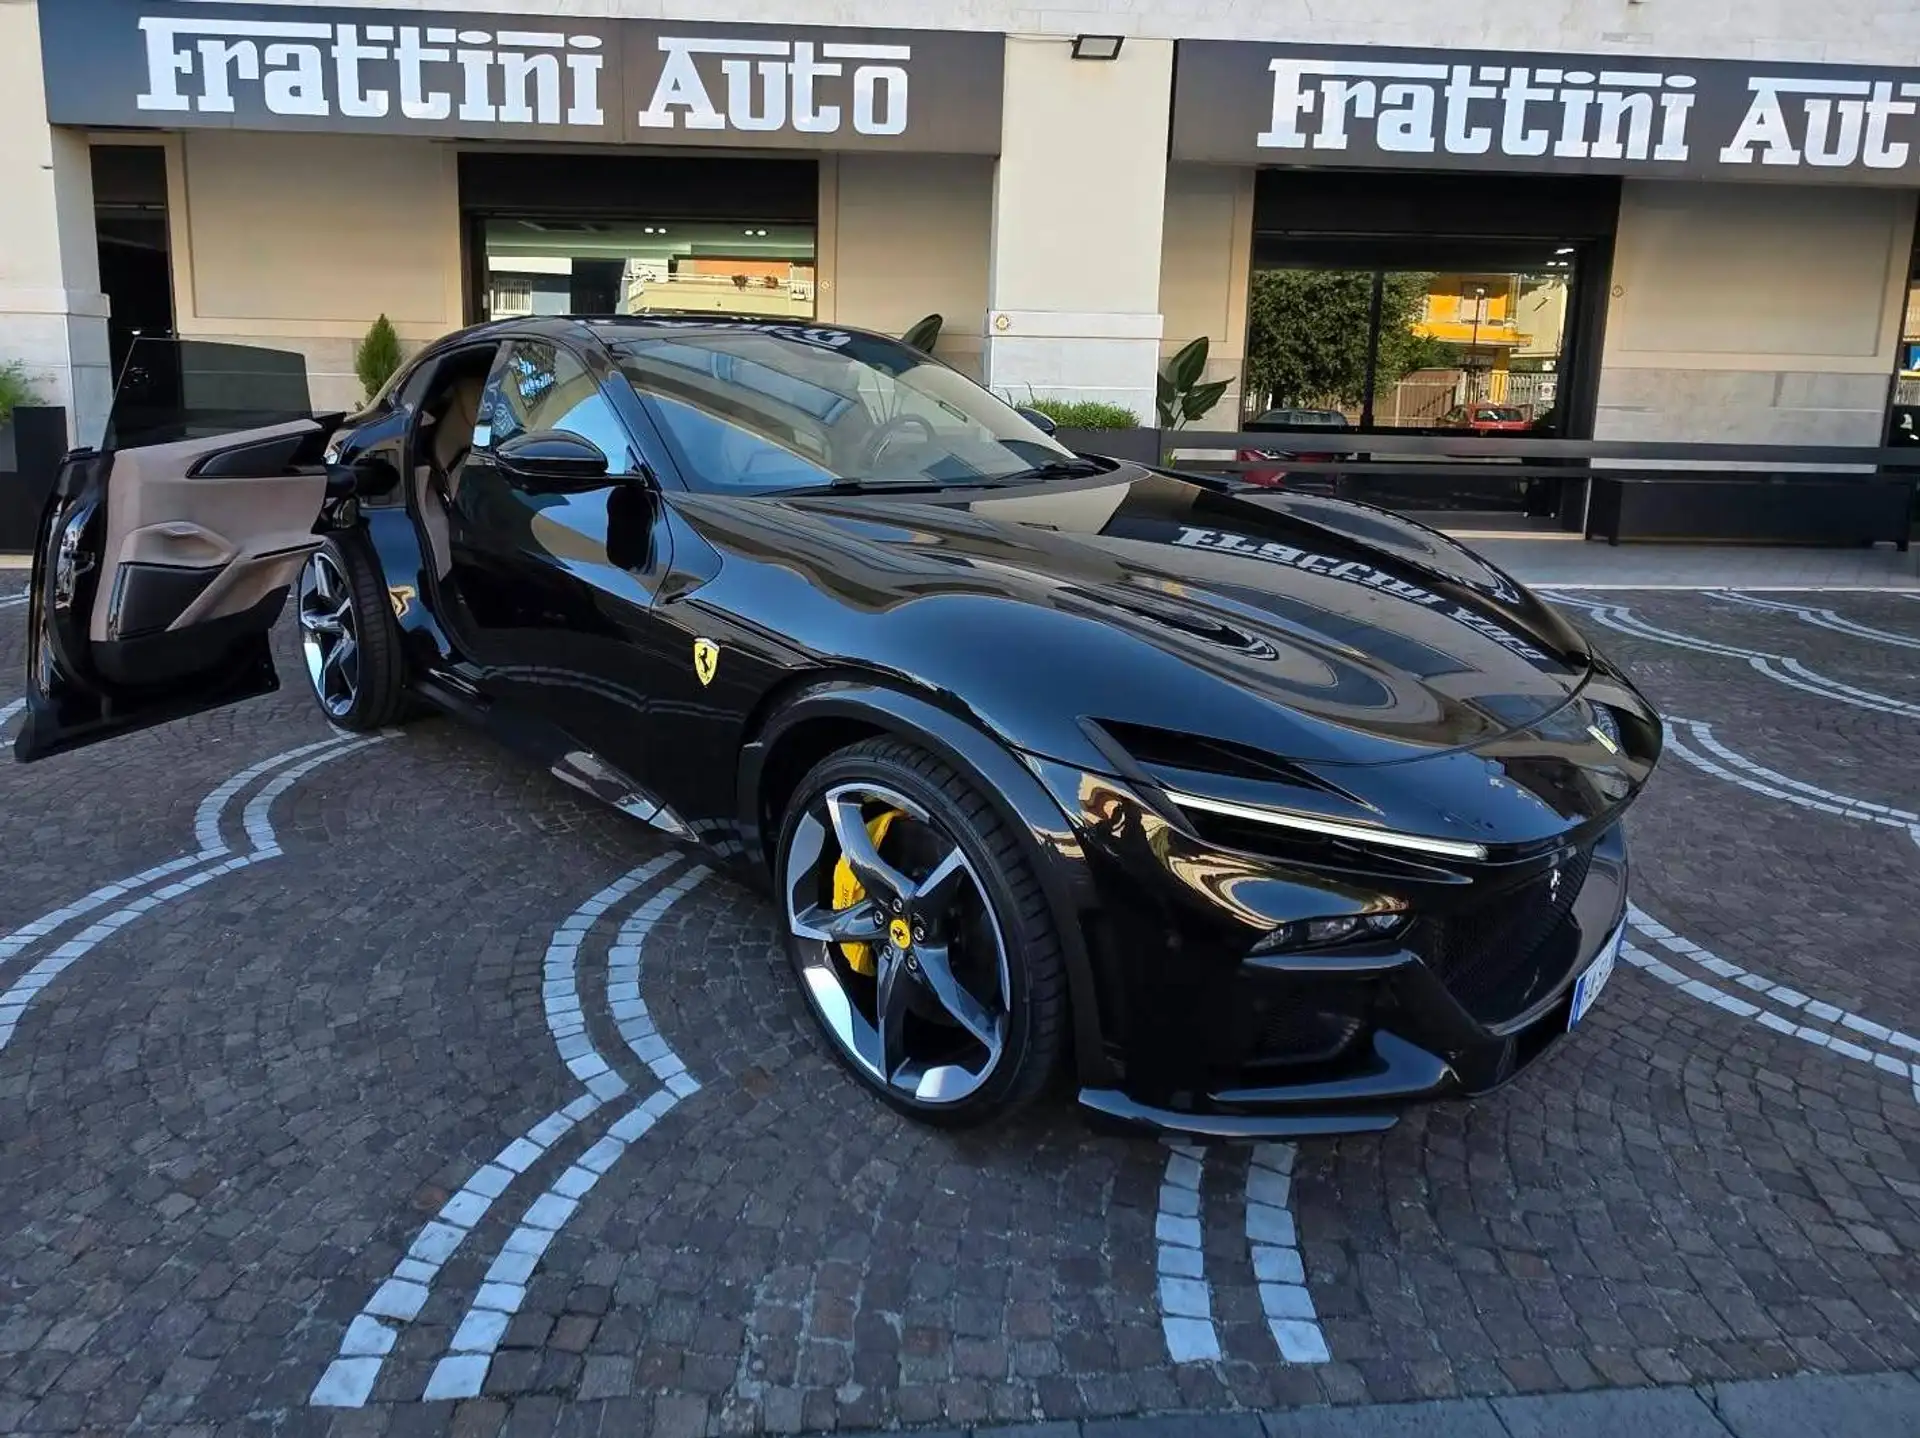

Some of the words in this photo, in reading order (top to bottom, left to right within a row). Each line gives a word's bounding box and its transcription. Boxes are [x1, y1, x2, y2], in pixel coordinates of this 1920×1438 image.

[136, 16, 604, 126] Frattini
[638, 36, 911, 135] Auto
[1256, 58, 1697, 161] Frattini
[1719, 76, 1920, 169] Aut
